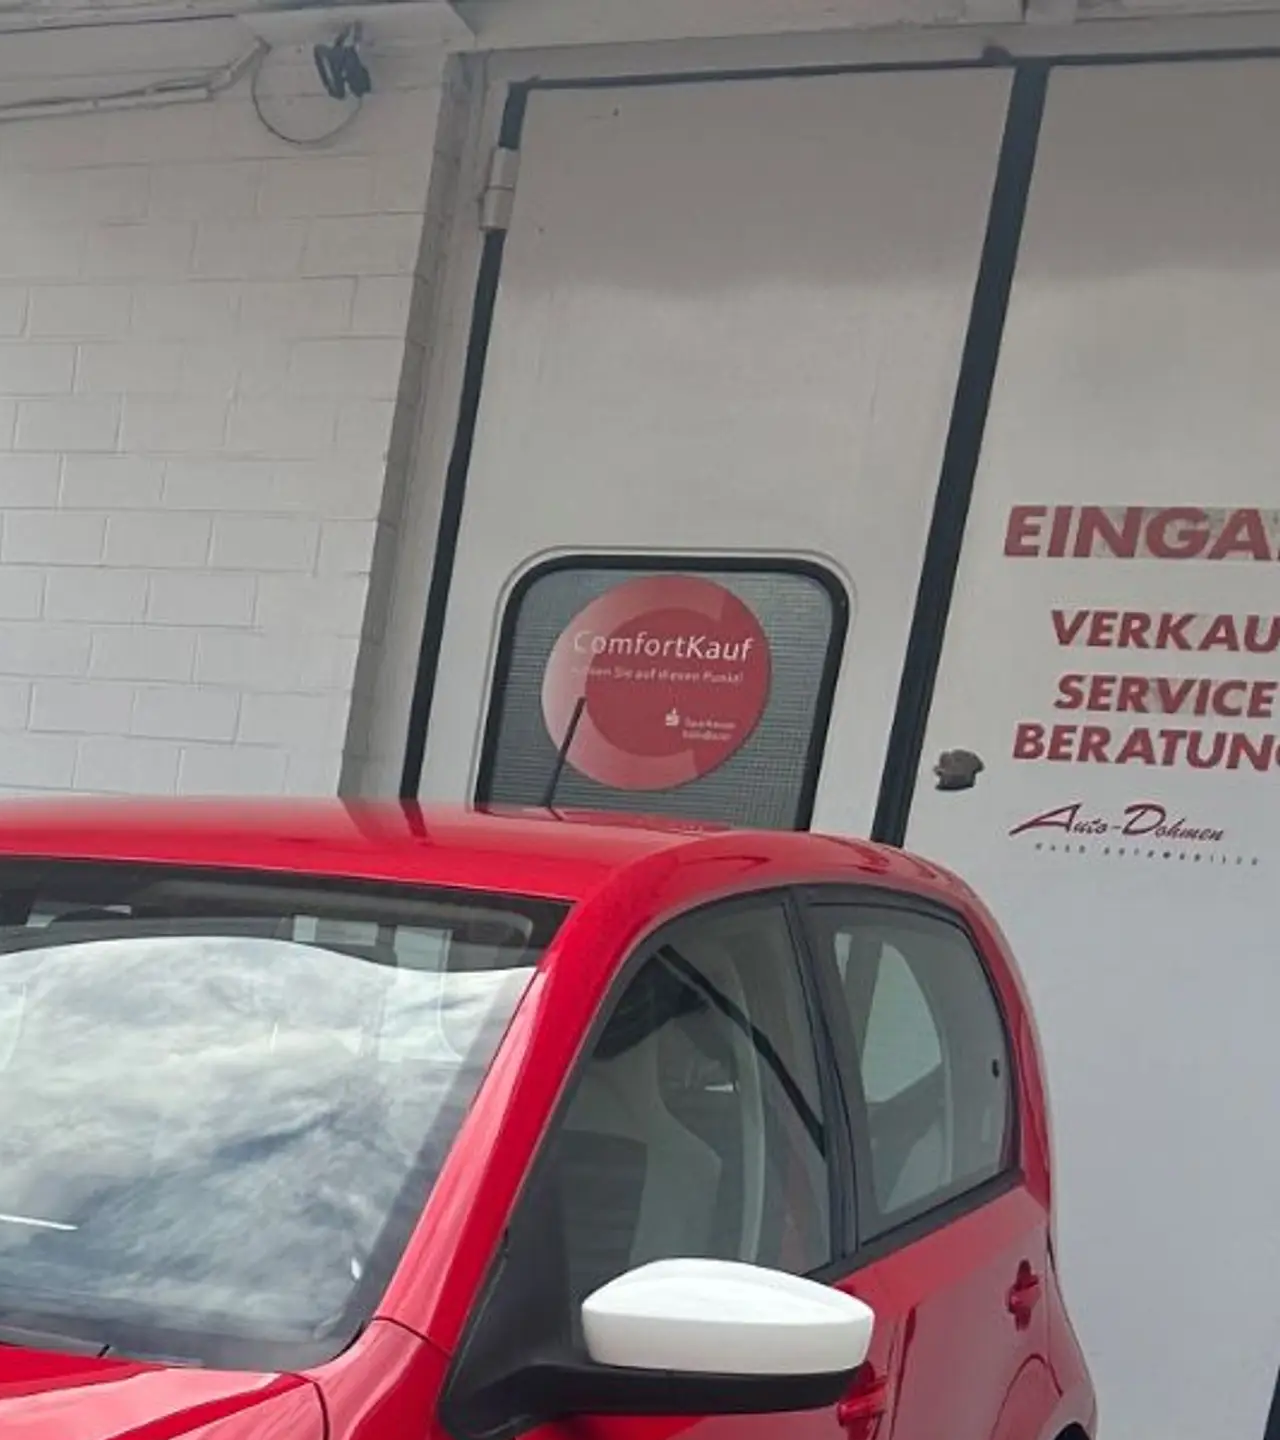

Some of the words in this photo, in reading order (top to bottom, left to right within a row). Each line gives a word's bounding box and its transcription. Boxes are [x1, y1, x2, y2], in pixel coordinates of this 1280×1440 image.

[1002, 505, 1280, 562] EINGA
[573, 631, 755, 662] ComfortKauf
[1051, 609, 1280, 654] VERKAU
[1052, 673, 1278, 719] SERVICE
[1011, 722, 1280, 772] BERATUN
